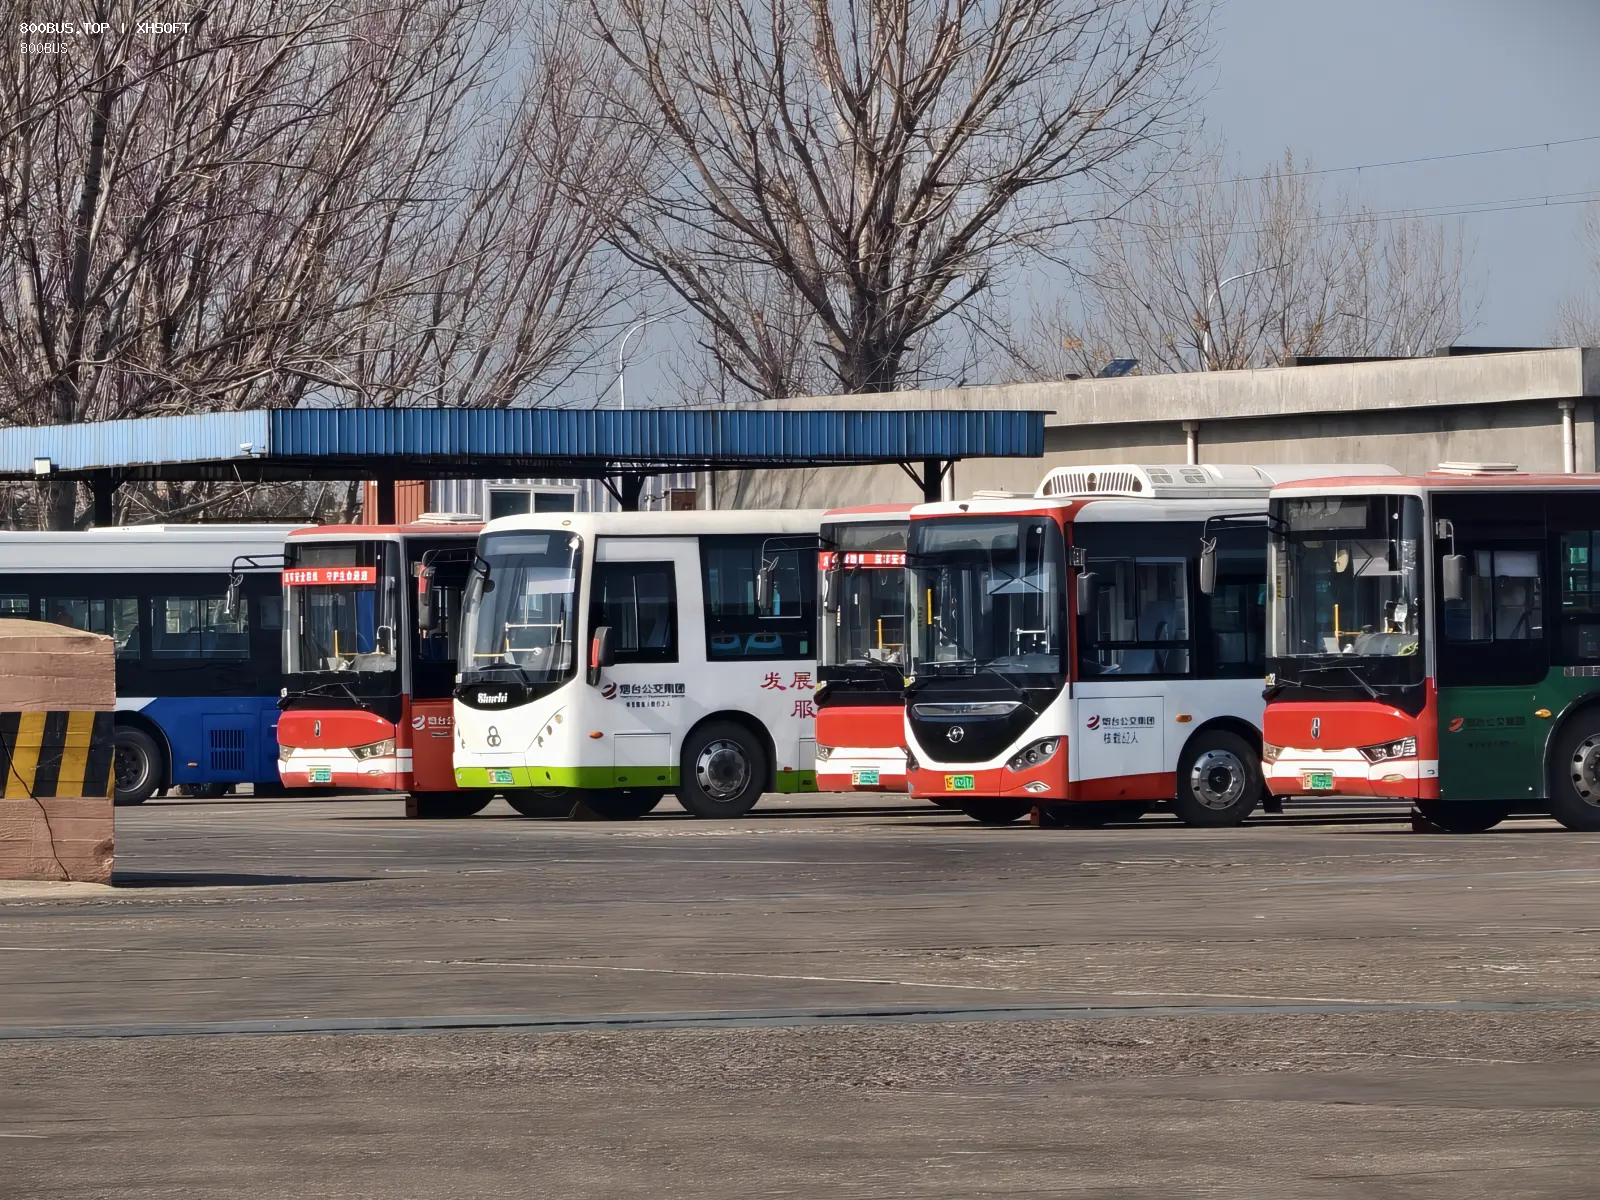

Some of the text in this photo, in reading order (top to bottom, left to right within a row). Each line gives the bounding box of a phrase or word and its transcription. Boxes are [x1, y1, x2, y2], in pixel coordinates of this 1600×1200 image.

[619, 683, 686, 695] 烟台公交集团
[760, 671, 816, 691] 发展
[790, 700, 817, 719] 服
